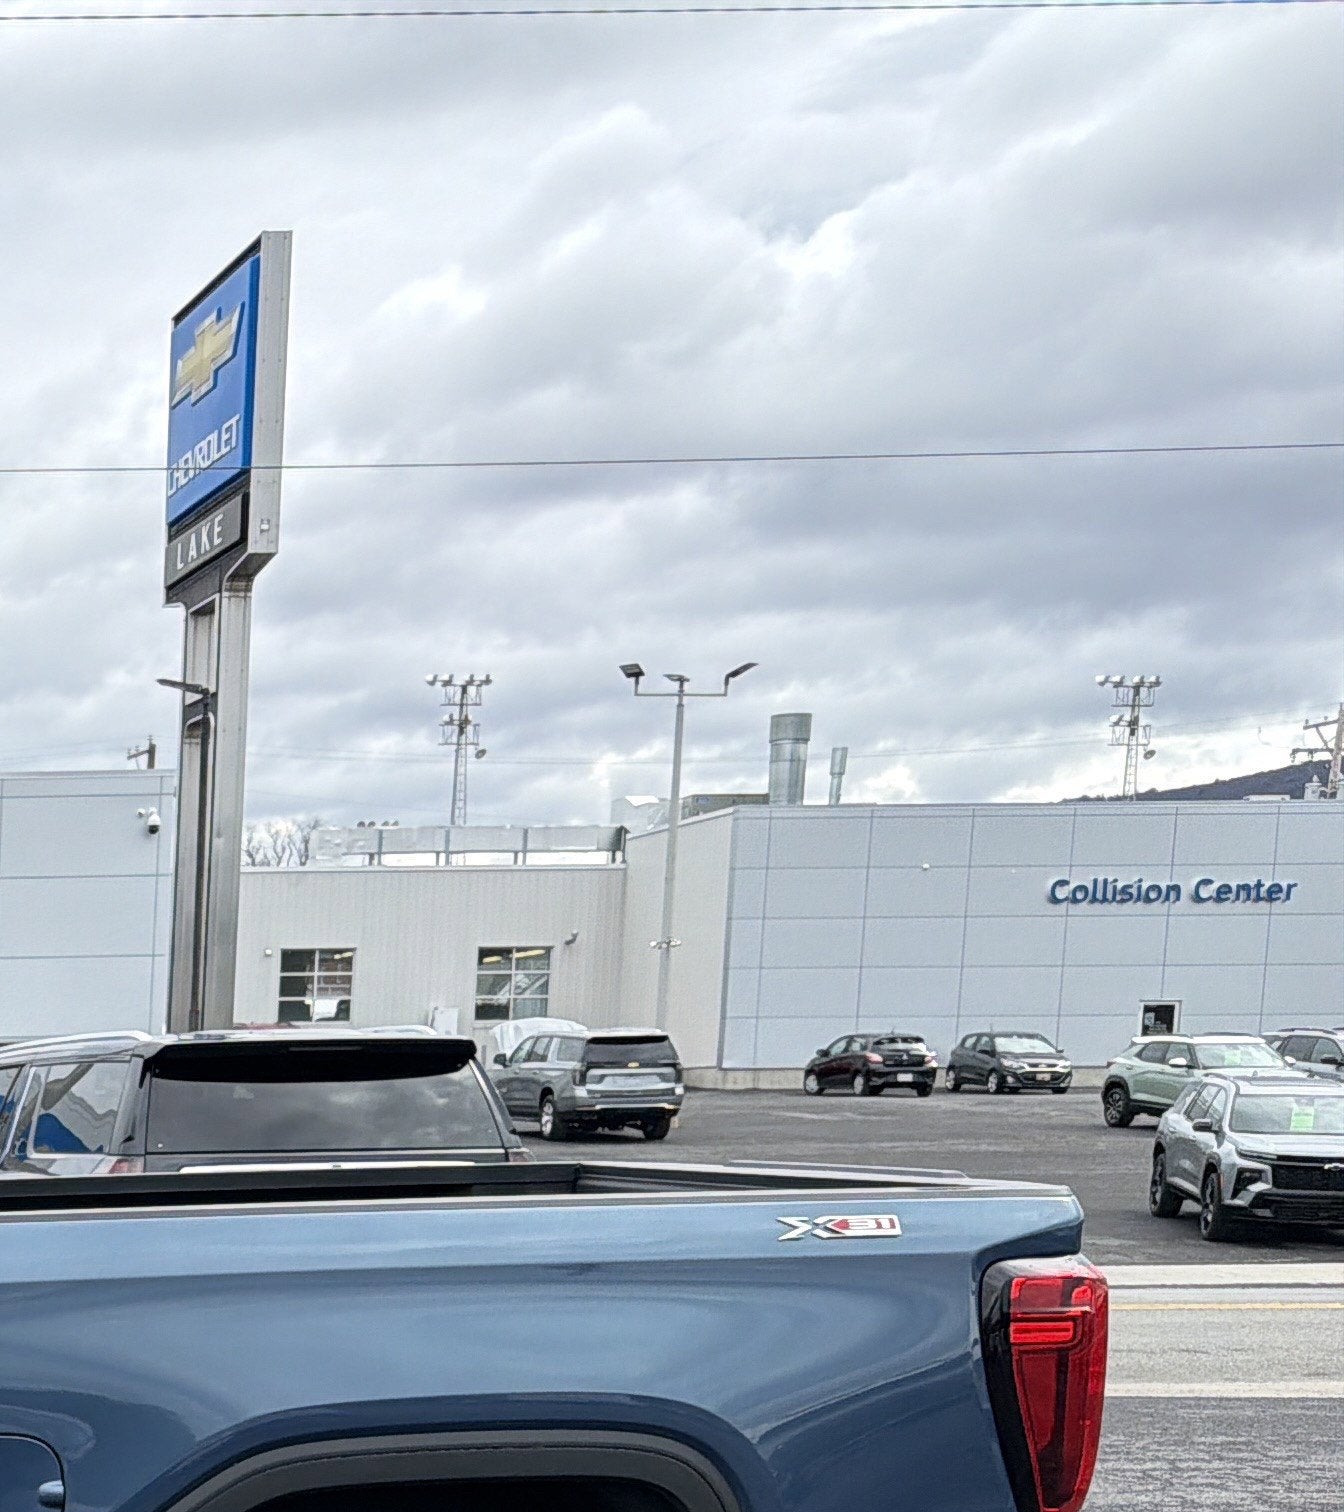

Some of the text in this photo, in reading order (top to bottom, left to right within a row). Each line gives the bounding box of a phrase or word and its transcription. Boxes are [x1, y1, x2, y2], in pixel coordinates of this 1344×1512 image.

[168, 414, 241, 497] CHEVROLET
[176, 512, 225, 570] LAKE
[1048, 877, 1298, 905] Collision Center
[776, 1214, 903, 1242] X31
